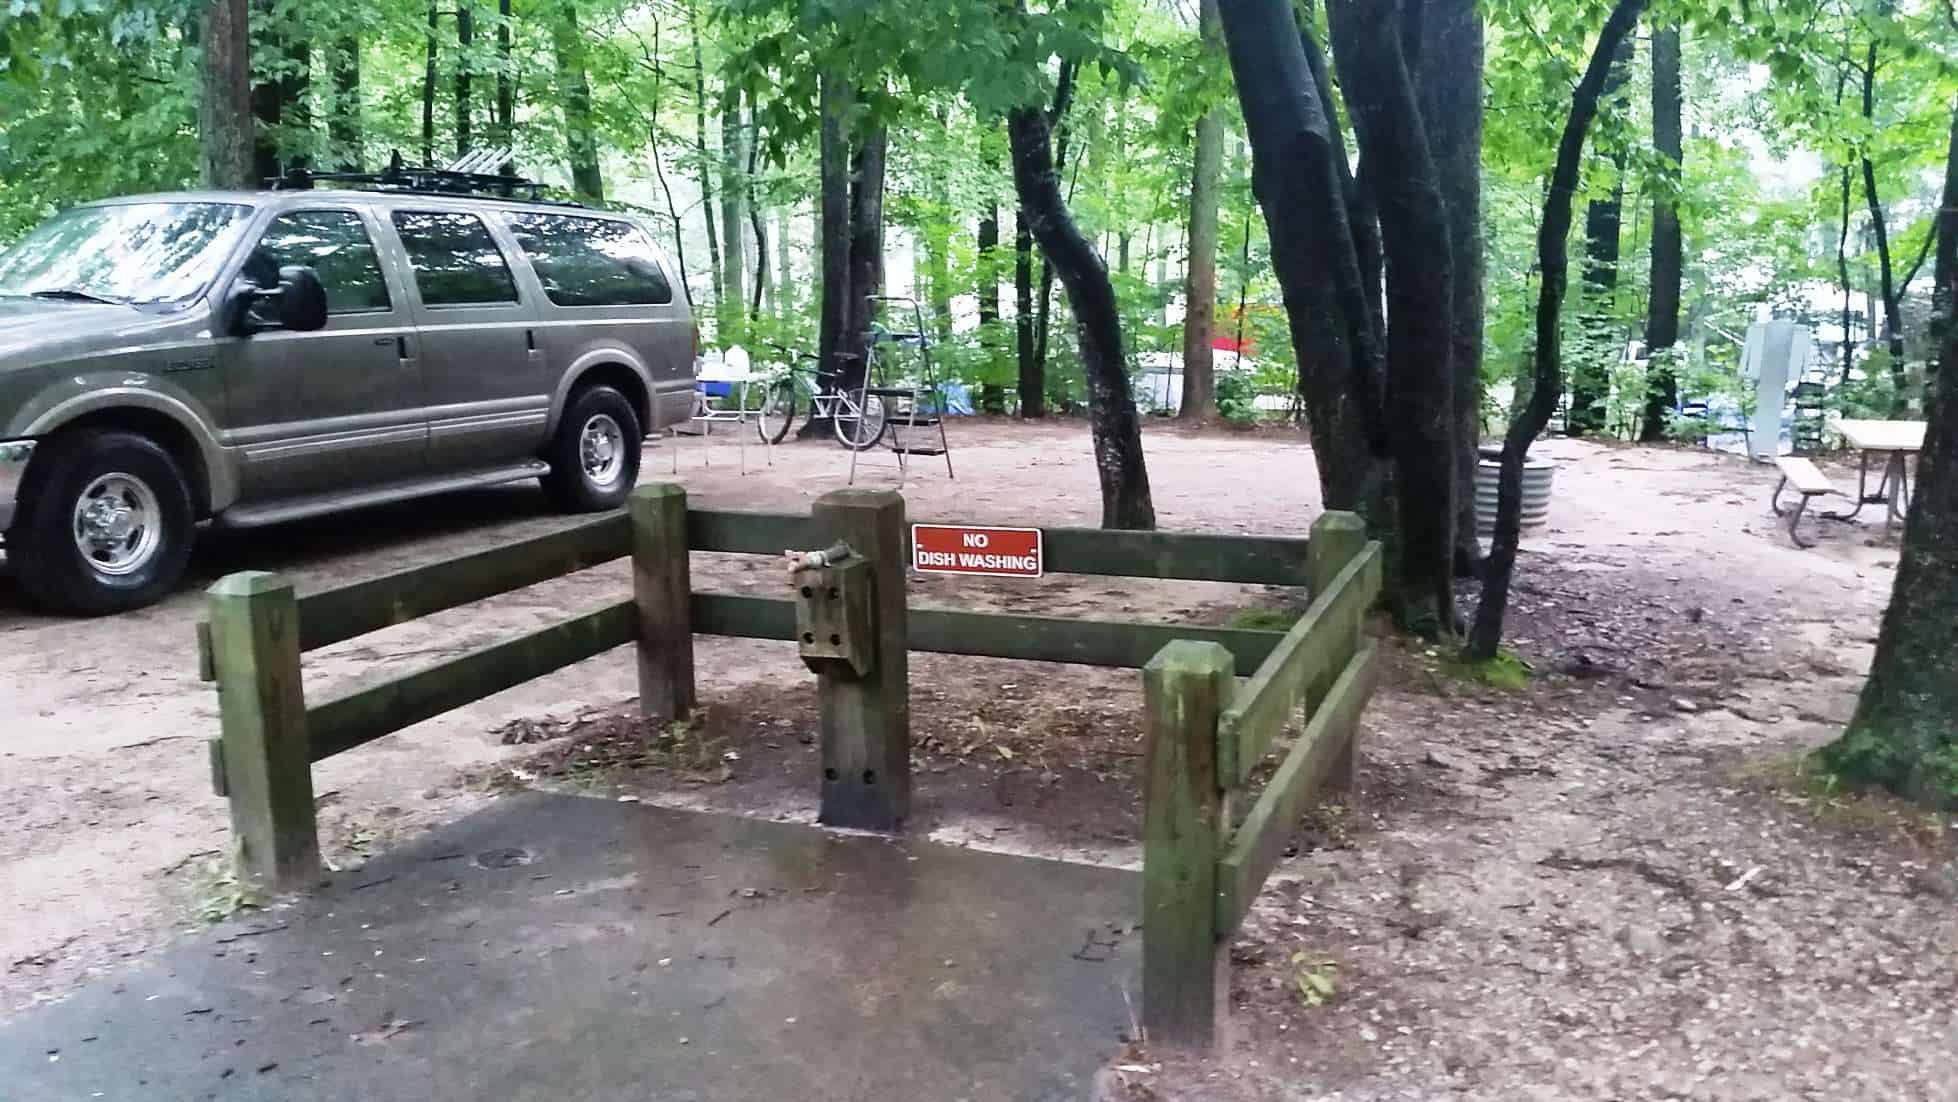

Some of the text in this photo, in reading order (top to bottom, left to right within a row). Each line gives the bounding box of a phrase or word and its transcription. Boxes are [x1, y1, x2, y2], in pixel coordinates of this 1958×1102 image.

[963, 533, 989, 548] NO
[918, 551, 1037, 570] DISH WASHING
